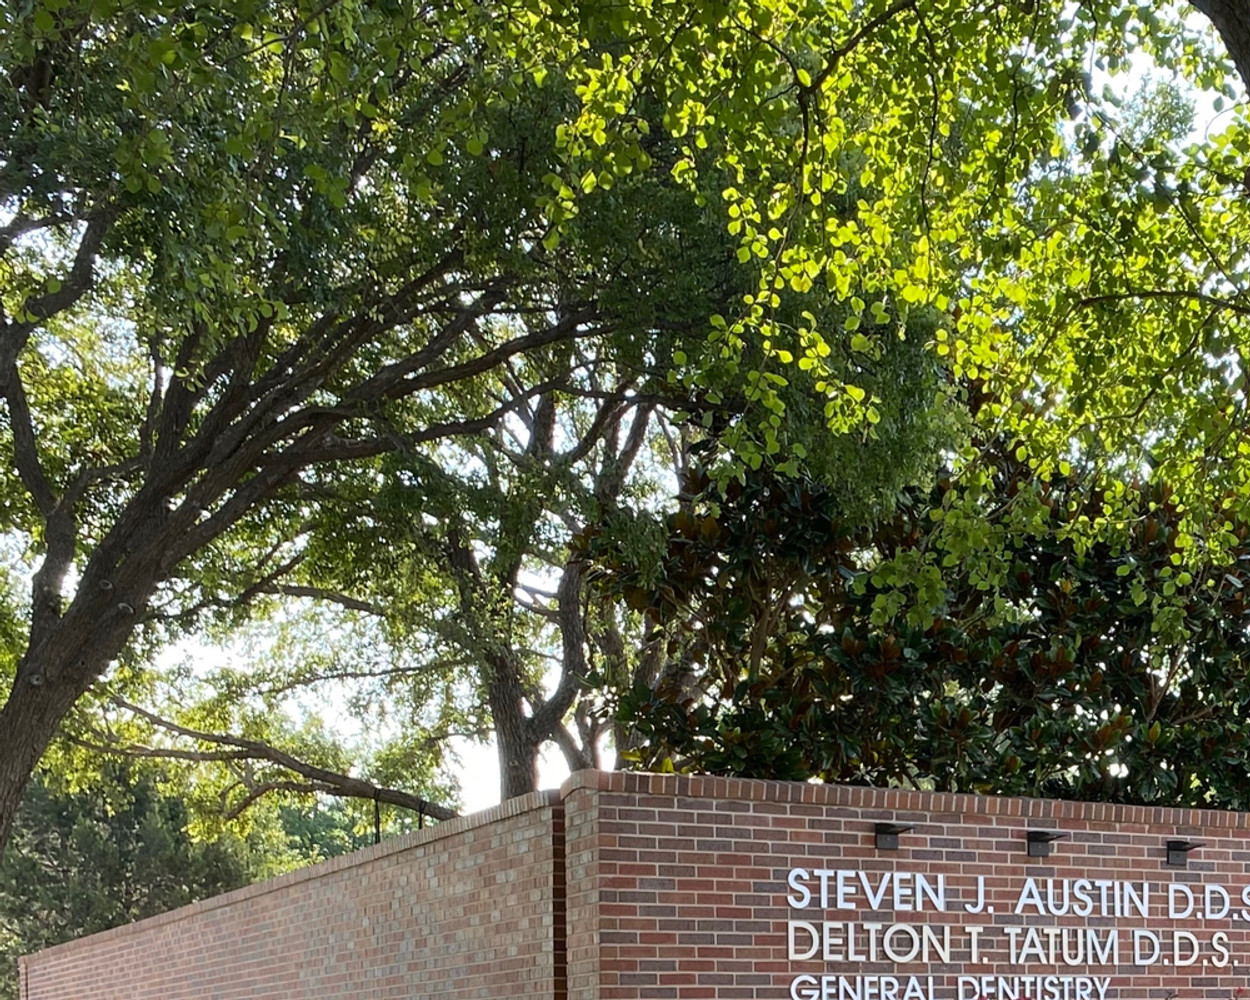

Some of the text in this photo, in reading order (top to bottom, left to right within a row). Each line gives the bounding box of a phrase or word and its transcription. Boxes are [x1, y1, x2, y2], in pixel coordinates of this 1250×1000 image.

[787, 868, 945, 912] STEVEN
[964, 875, 994, 914] J.
[1014, 877, 1149, 918] AUSTIN
[787, 921, 1239, 968] DELTON T. TATUM D.D.S.
